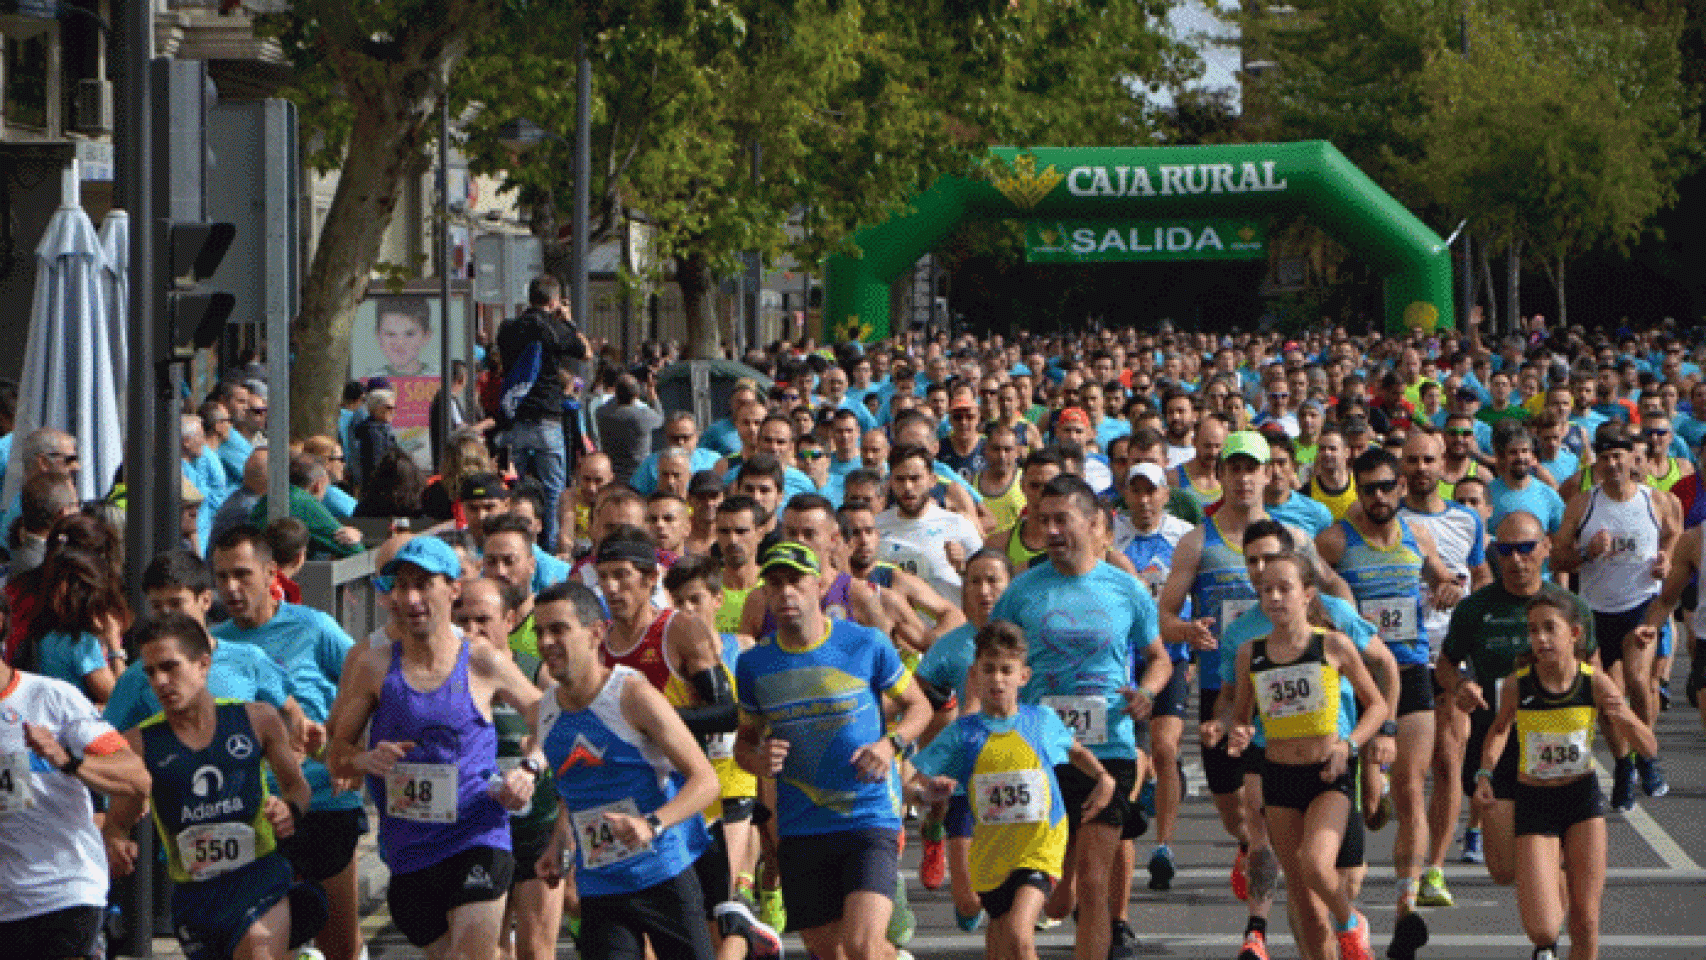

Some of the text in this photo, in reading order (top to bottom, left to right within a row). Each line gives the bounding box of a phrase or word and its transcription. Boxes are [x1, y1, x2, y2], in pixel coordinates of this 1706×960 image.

[1067, 161, 1288, 197] CAJA RURAL
[1072, 225, 1223, 252] SALIDA
[1380, 609, 1402, 627] 82
[1269, 678, 1310, 702] 350
[1541, 744, 1579, 765] 438
[404, 779, 432, 801] 48
[990, 783, 1030, 807] 435
[181, 796, 244, 823] Adarsa
[195, 837, 239, 862] 550
